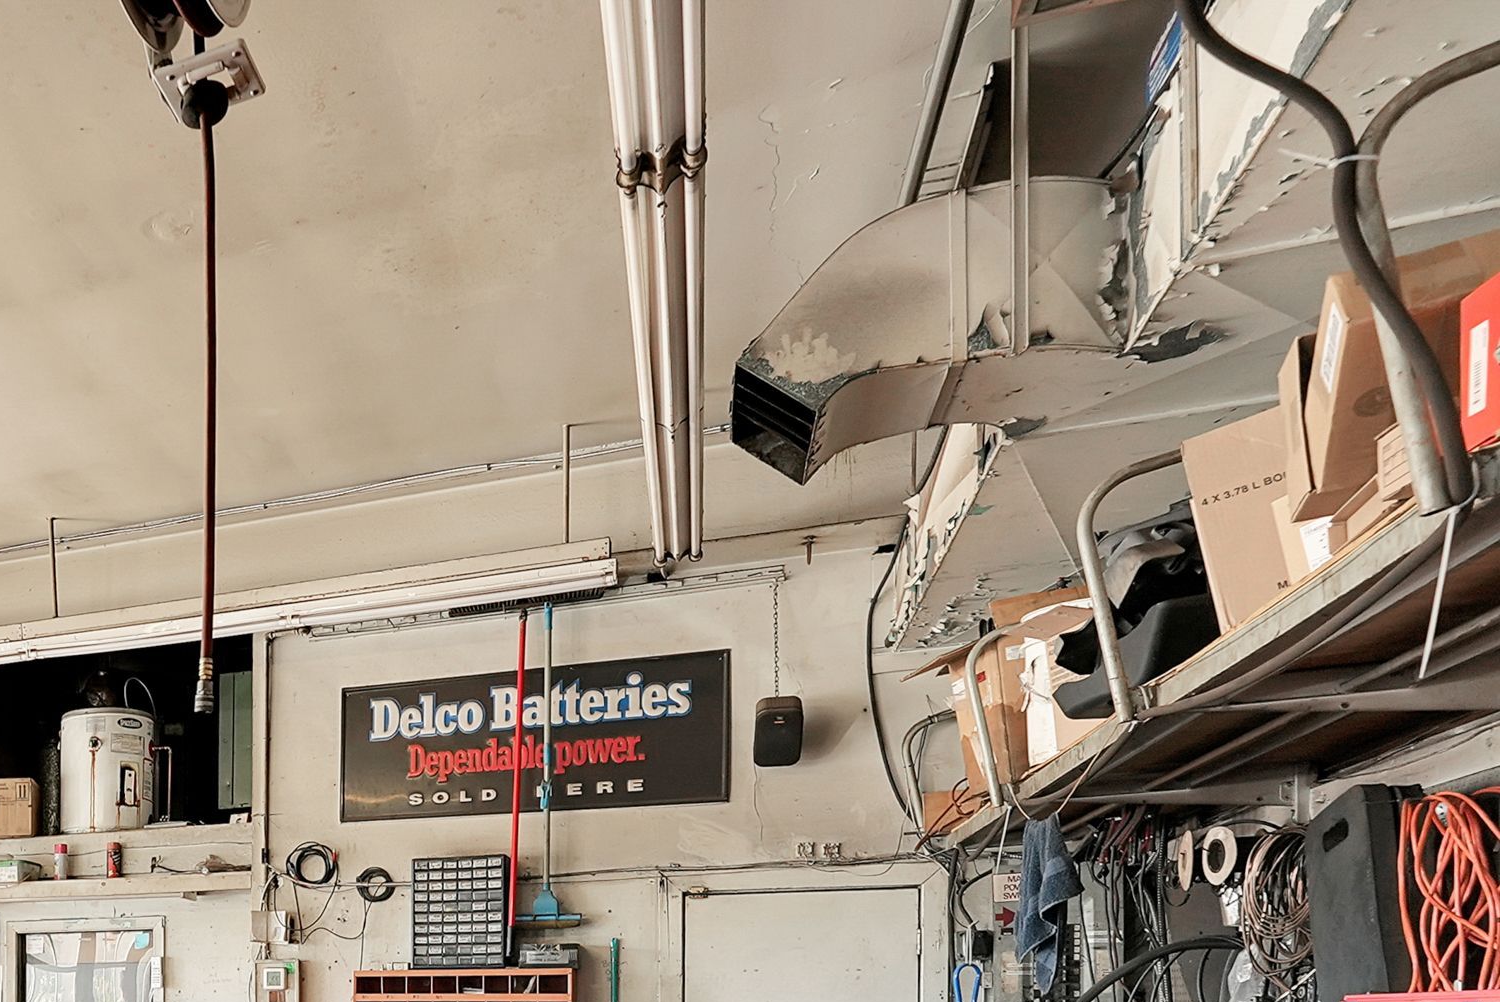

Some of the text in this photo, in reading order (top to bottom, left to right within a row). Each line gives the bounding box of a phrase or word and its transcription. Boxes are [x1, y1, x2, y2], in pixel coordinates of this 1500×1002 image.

[1201, 498, 1209, 506] 4
[1212, 494, 1221, 503] X
[1224, 485, 1249, 500] 3.78
[1252, 482, 1261, 490] L
[369, 671, 692, 742] Delco Batteries
[554, 735, 645, 775] power.
[408, 788, 498, 806] SOLD
